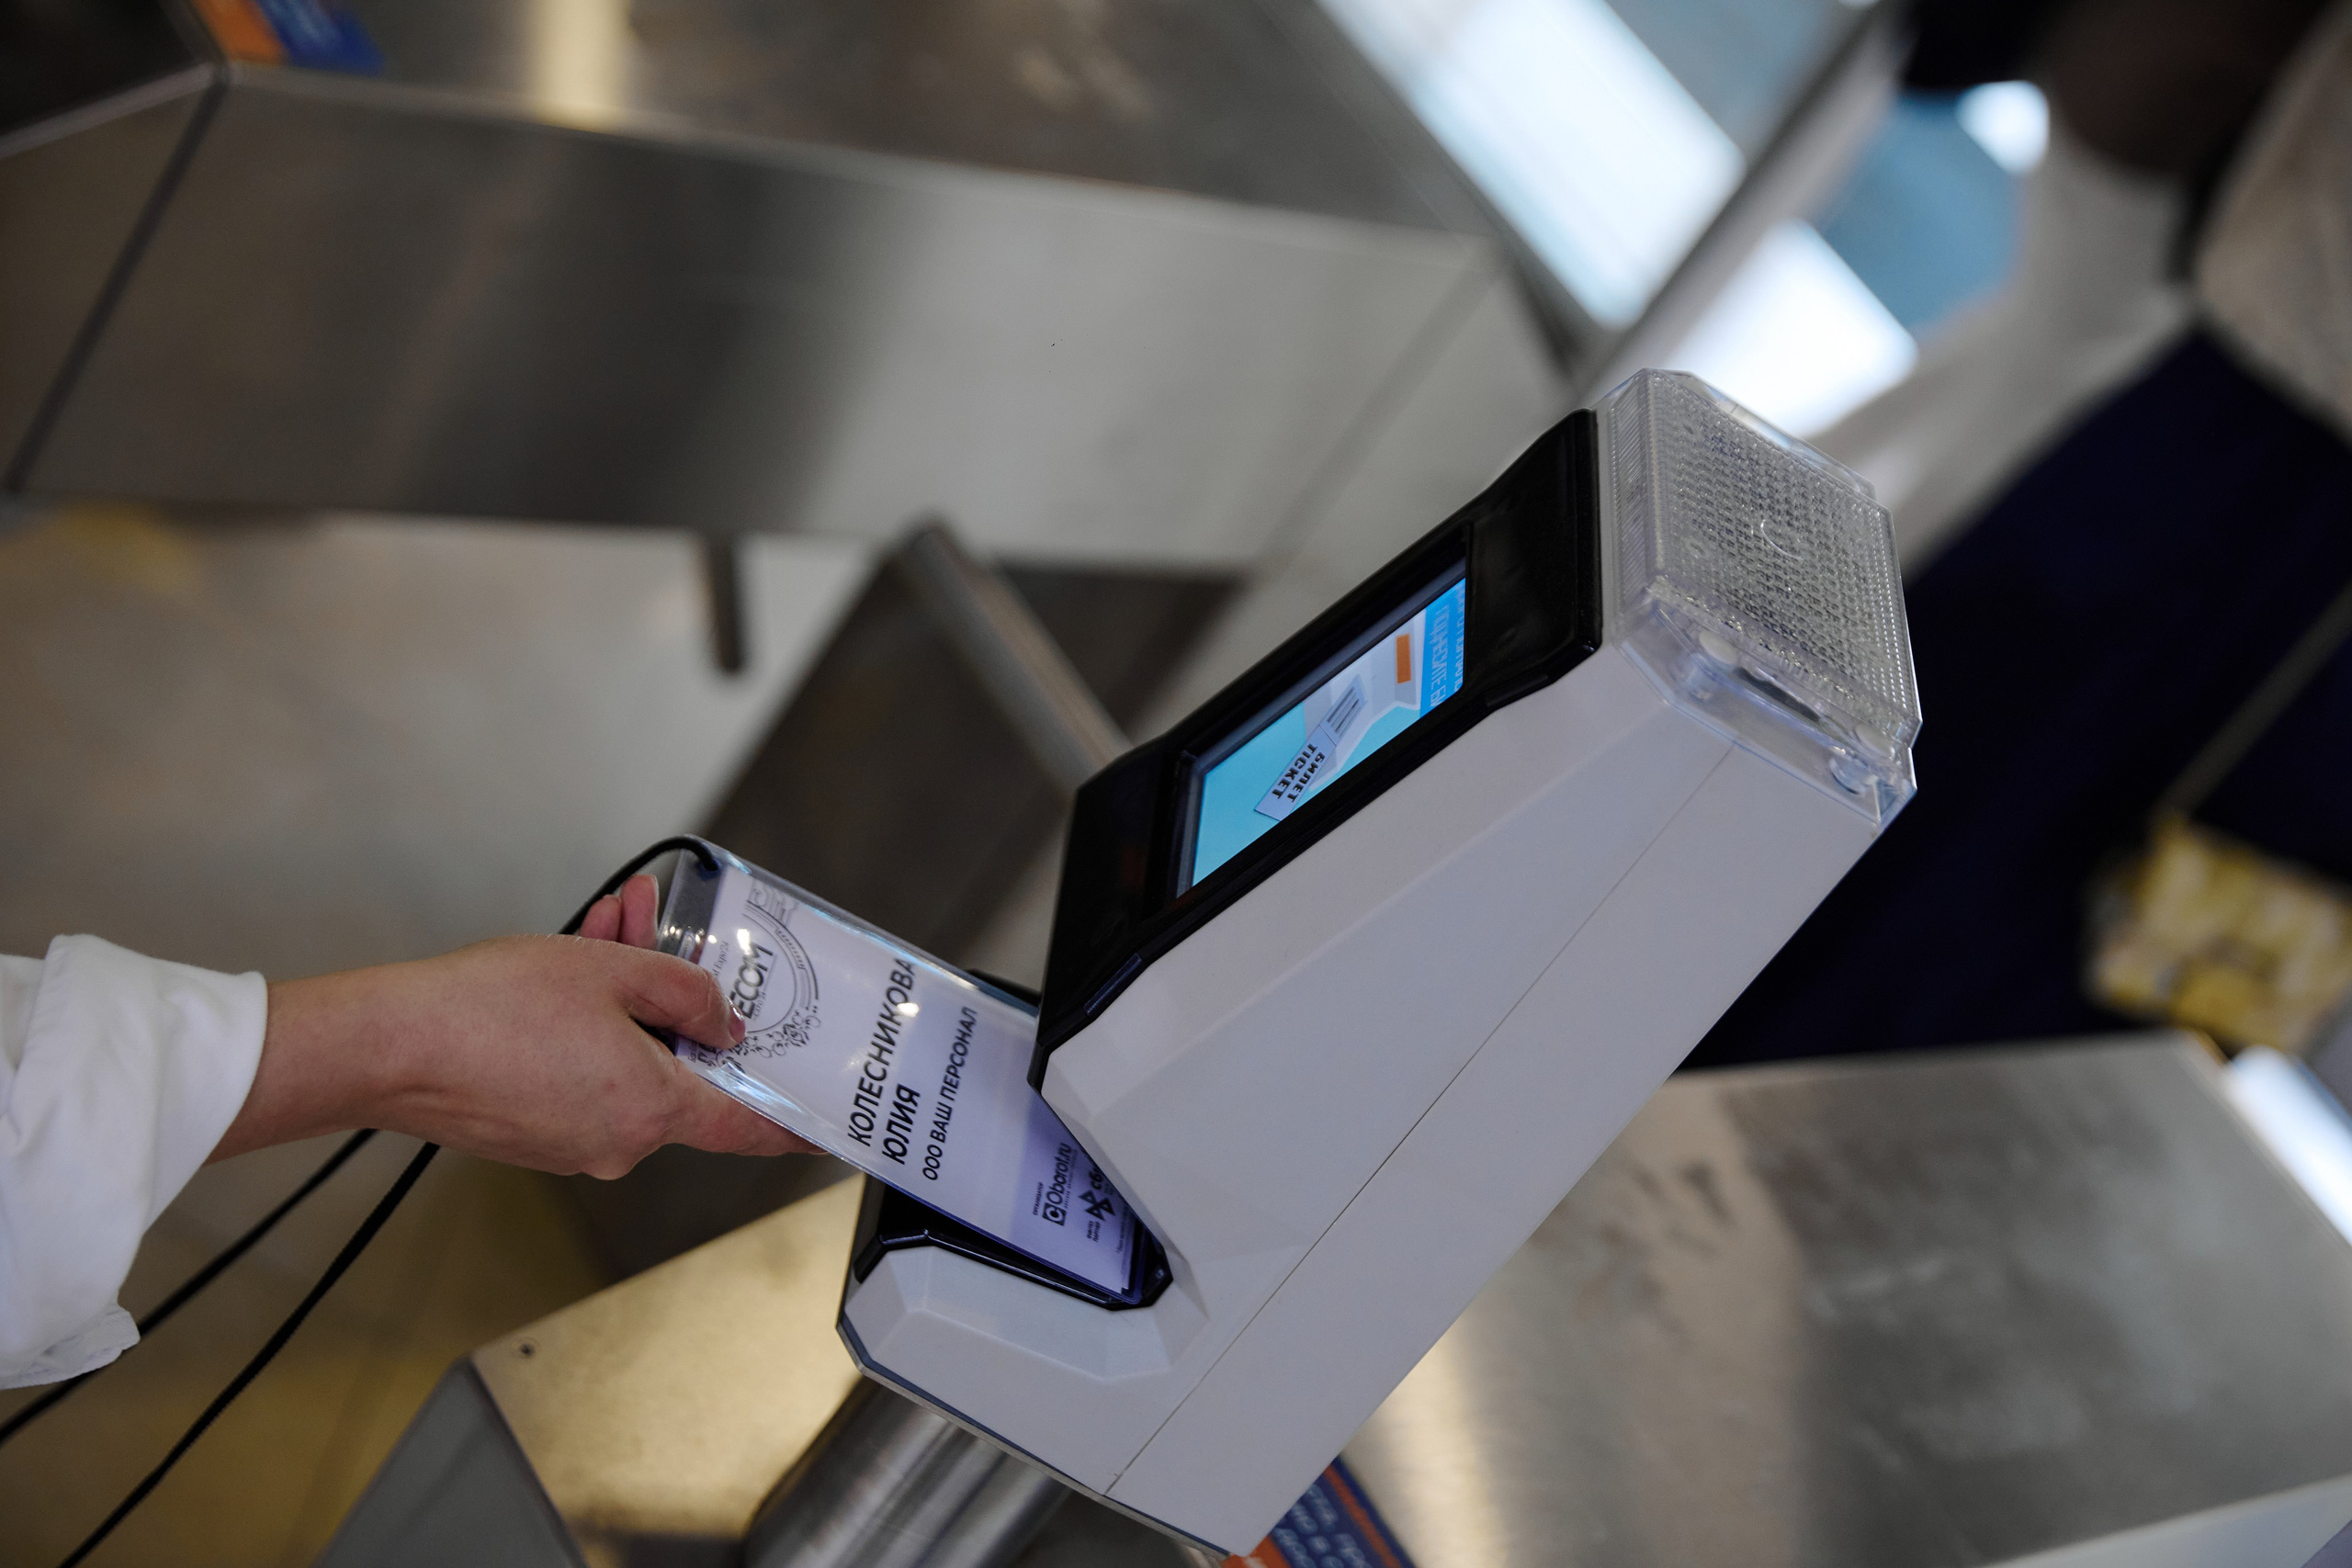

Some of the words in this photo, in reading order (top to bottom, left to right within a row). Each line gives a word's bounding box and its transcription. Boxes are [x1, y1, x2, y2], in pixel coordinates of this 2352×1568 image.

[1272, 742, 1318, 799] TICKET
[1287, 751, 1326, 803] БИЛЕТ
[847, 955, 917, 1147] КОЛЕСНИКОВА
[939, 1007, 978, 1104] ПЕРСОНАЛ
[882, 1083, 921, 1166] ЮЛИЯ
[929, 1102, 955, 1145] ВАШ
[922, 1145, 940, 1181] ООО
